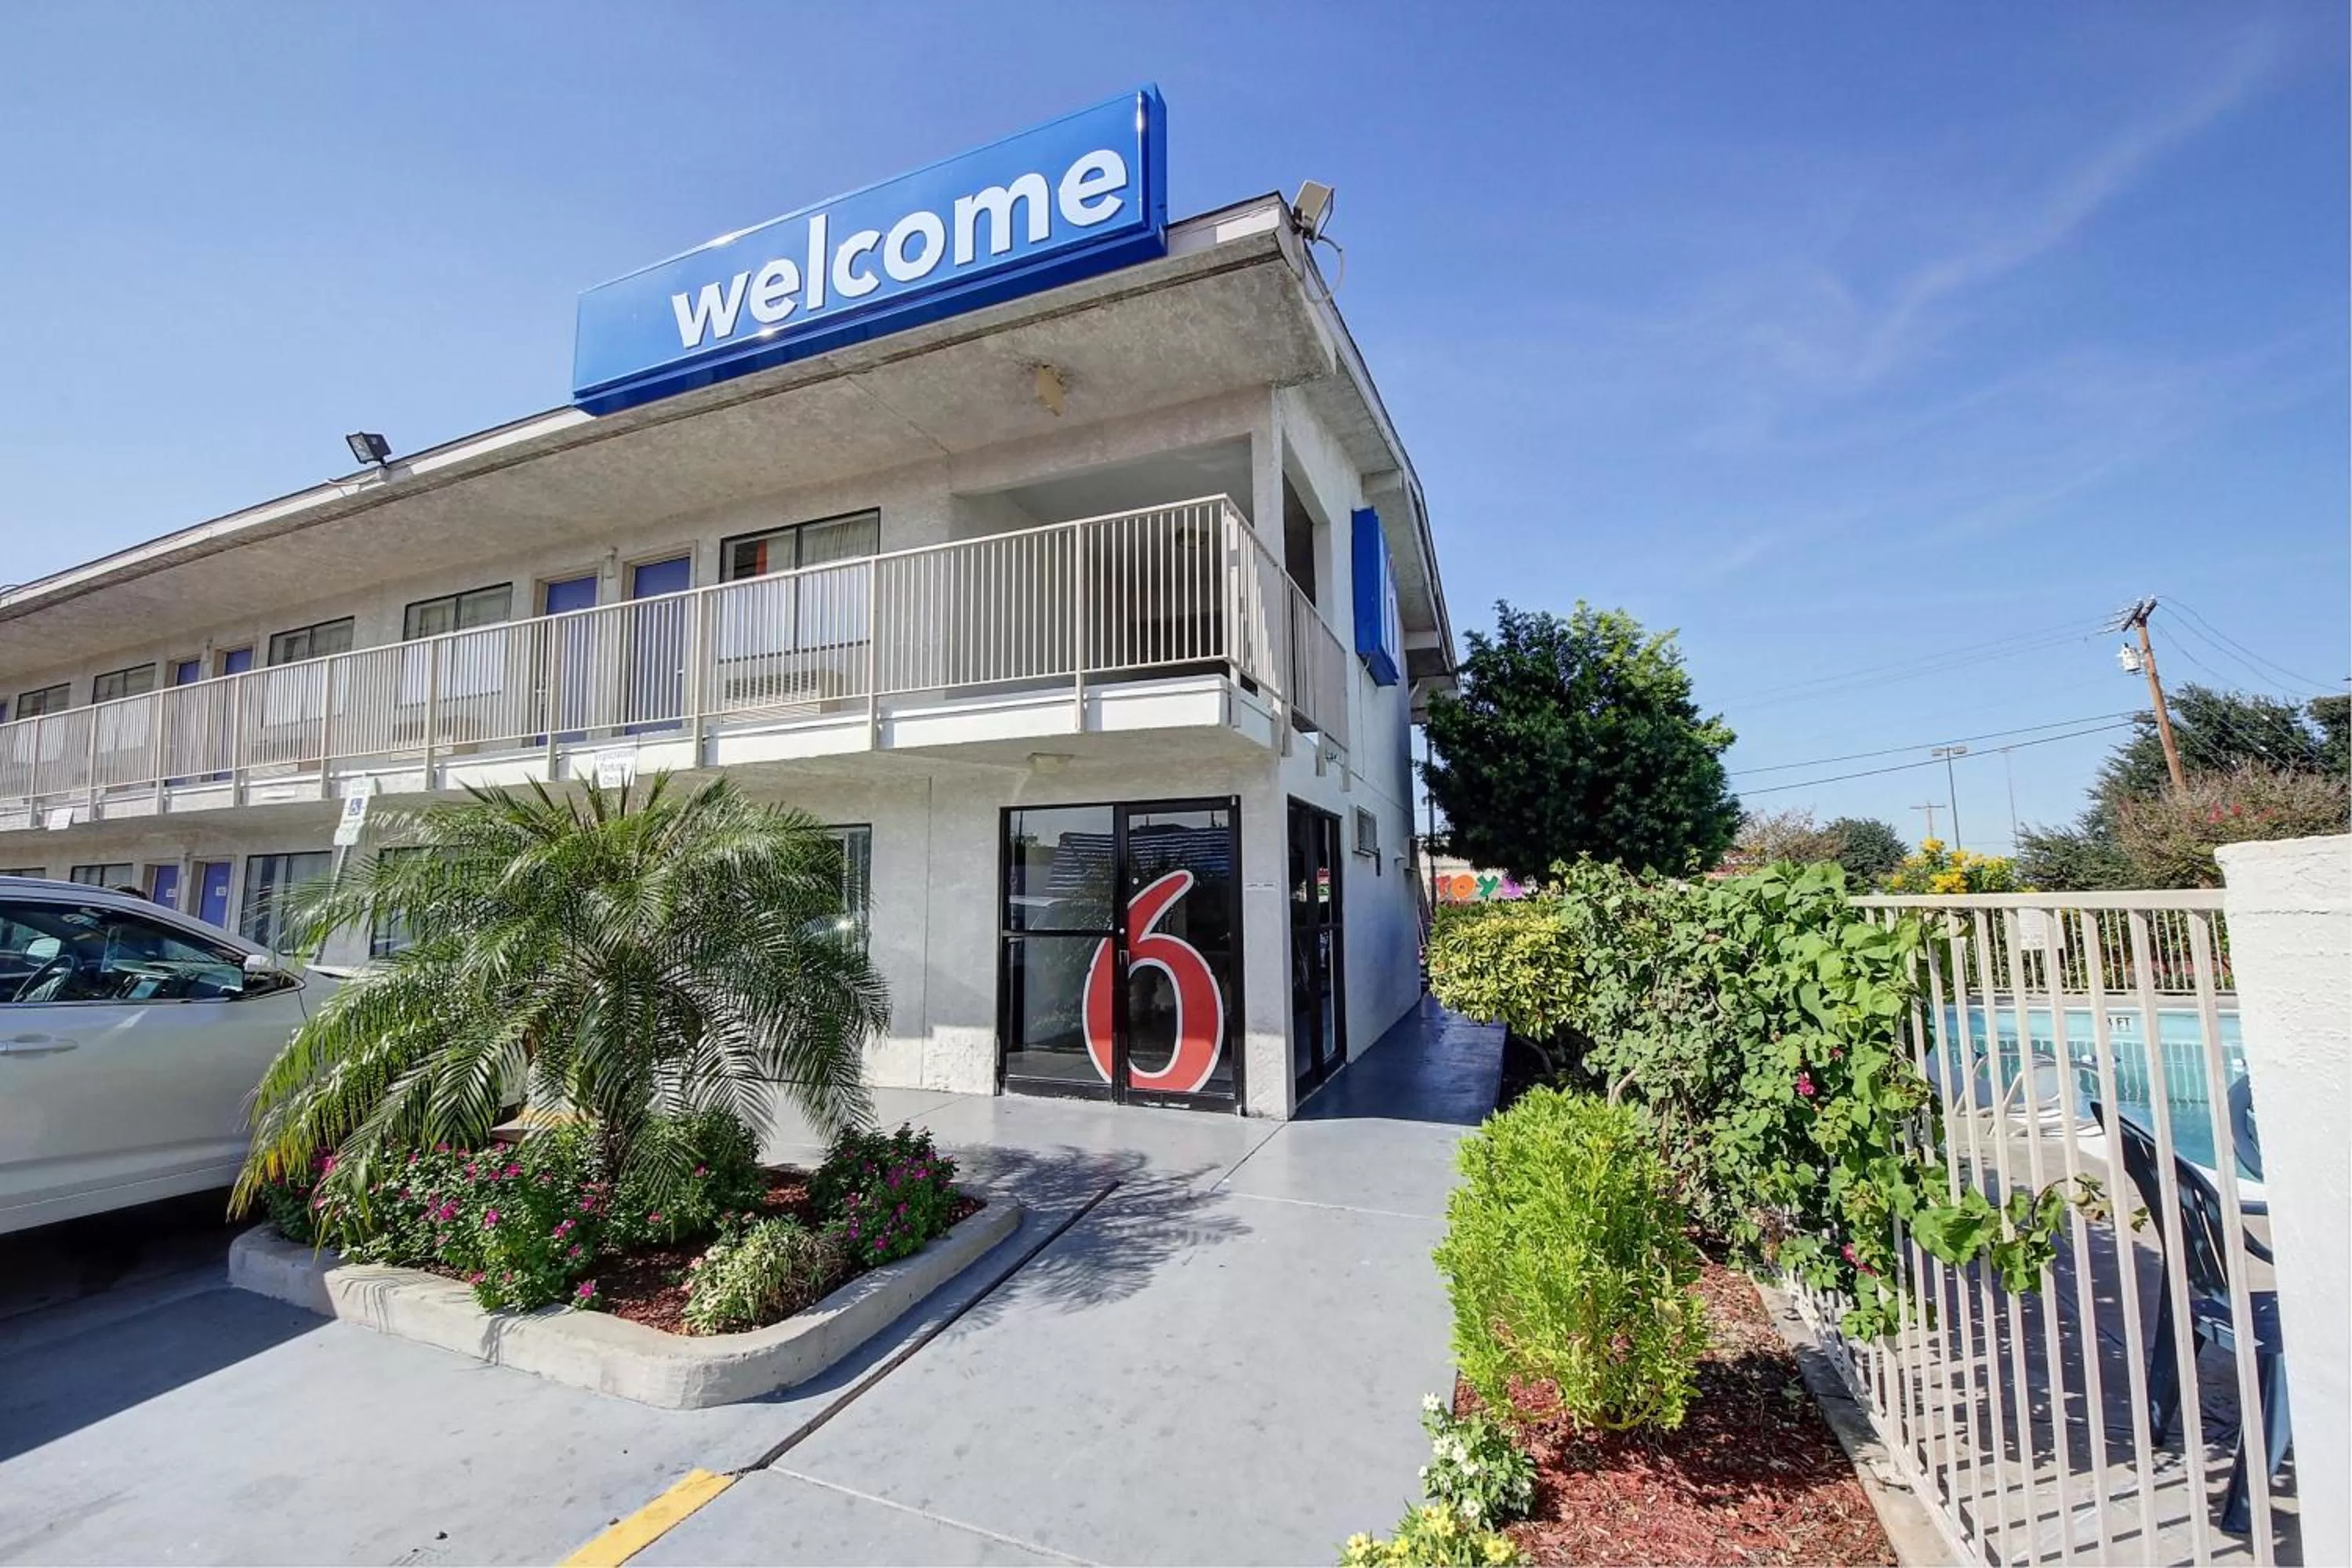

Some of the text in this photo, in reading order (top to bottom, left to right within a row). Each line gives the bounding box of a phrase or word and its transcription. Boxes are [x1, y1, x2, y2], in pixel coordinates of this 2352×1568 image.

[672, 149, 1127, 347] welcome
[1083, 870, 1223, 1092] 6
[2116, 1017, 2131, 1031] FT
